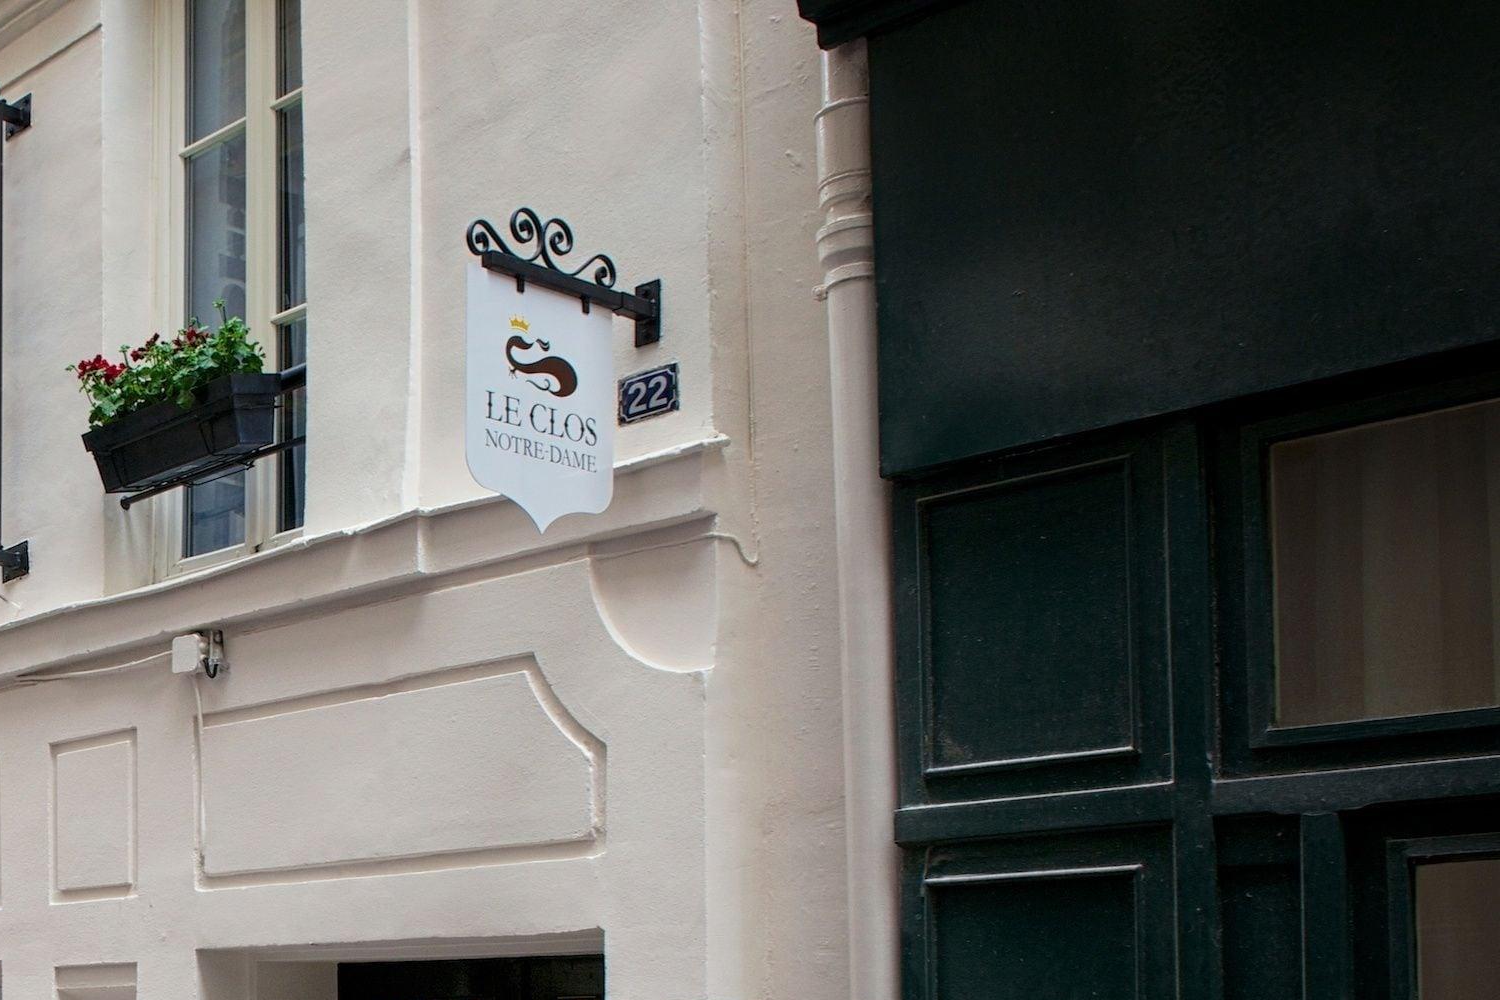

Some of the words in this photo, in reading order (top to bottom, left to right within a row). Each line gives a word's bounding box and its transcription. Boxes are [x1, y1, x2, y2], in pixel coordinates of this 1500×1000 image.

[626, 374, 669, 415] 22
[485, 389, 522, 427] LE
[529, 403, 598, 447] CLOS
[485, 428, 597, 474] NOTRE-DAME
